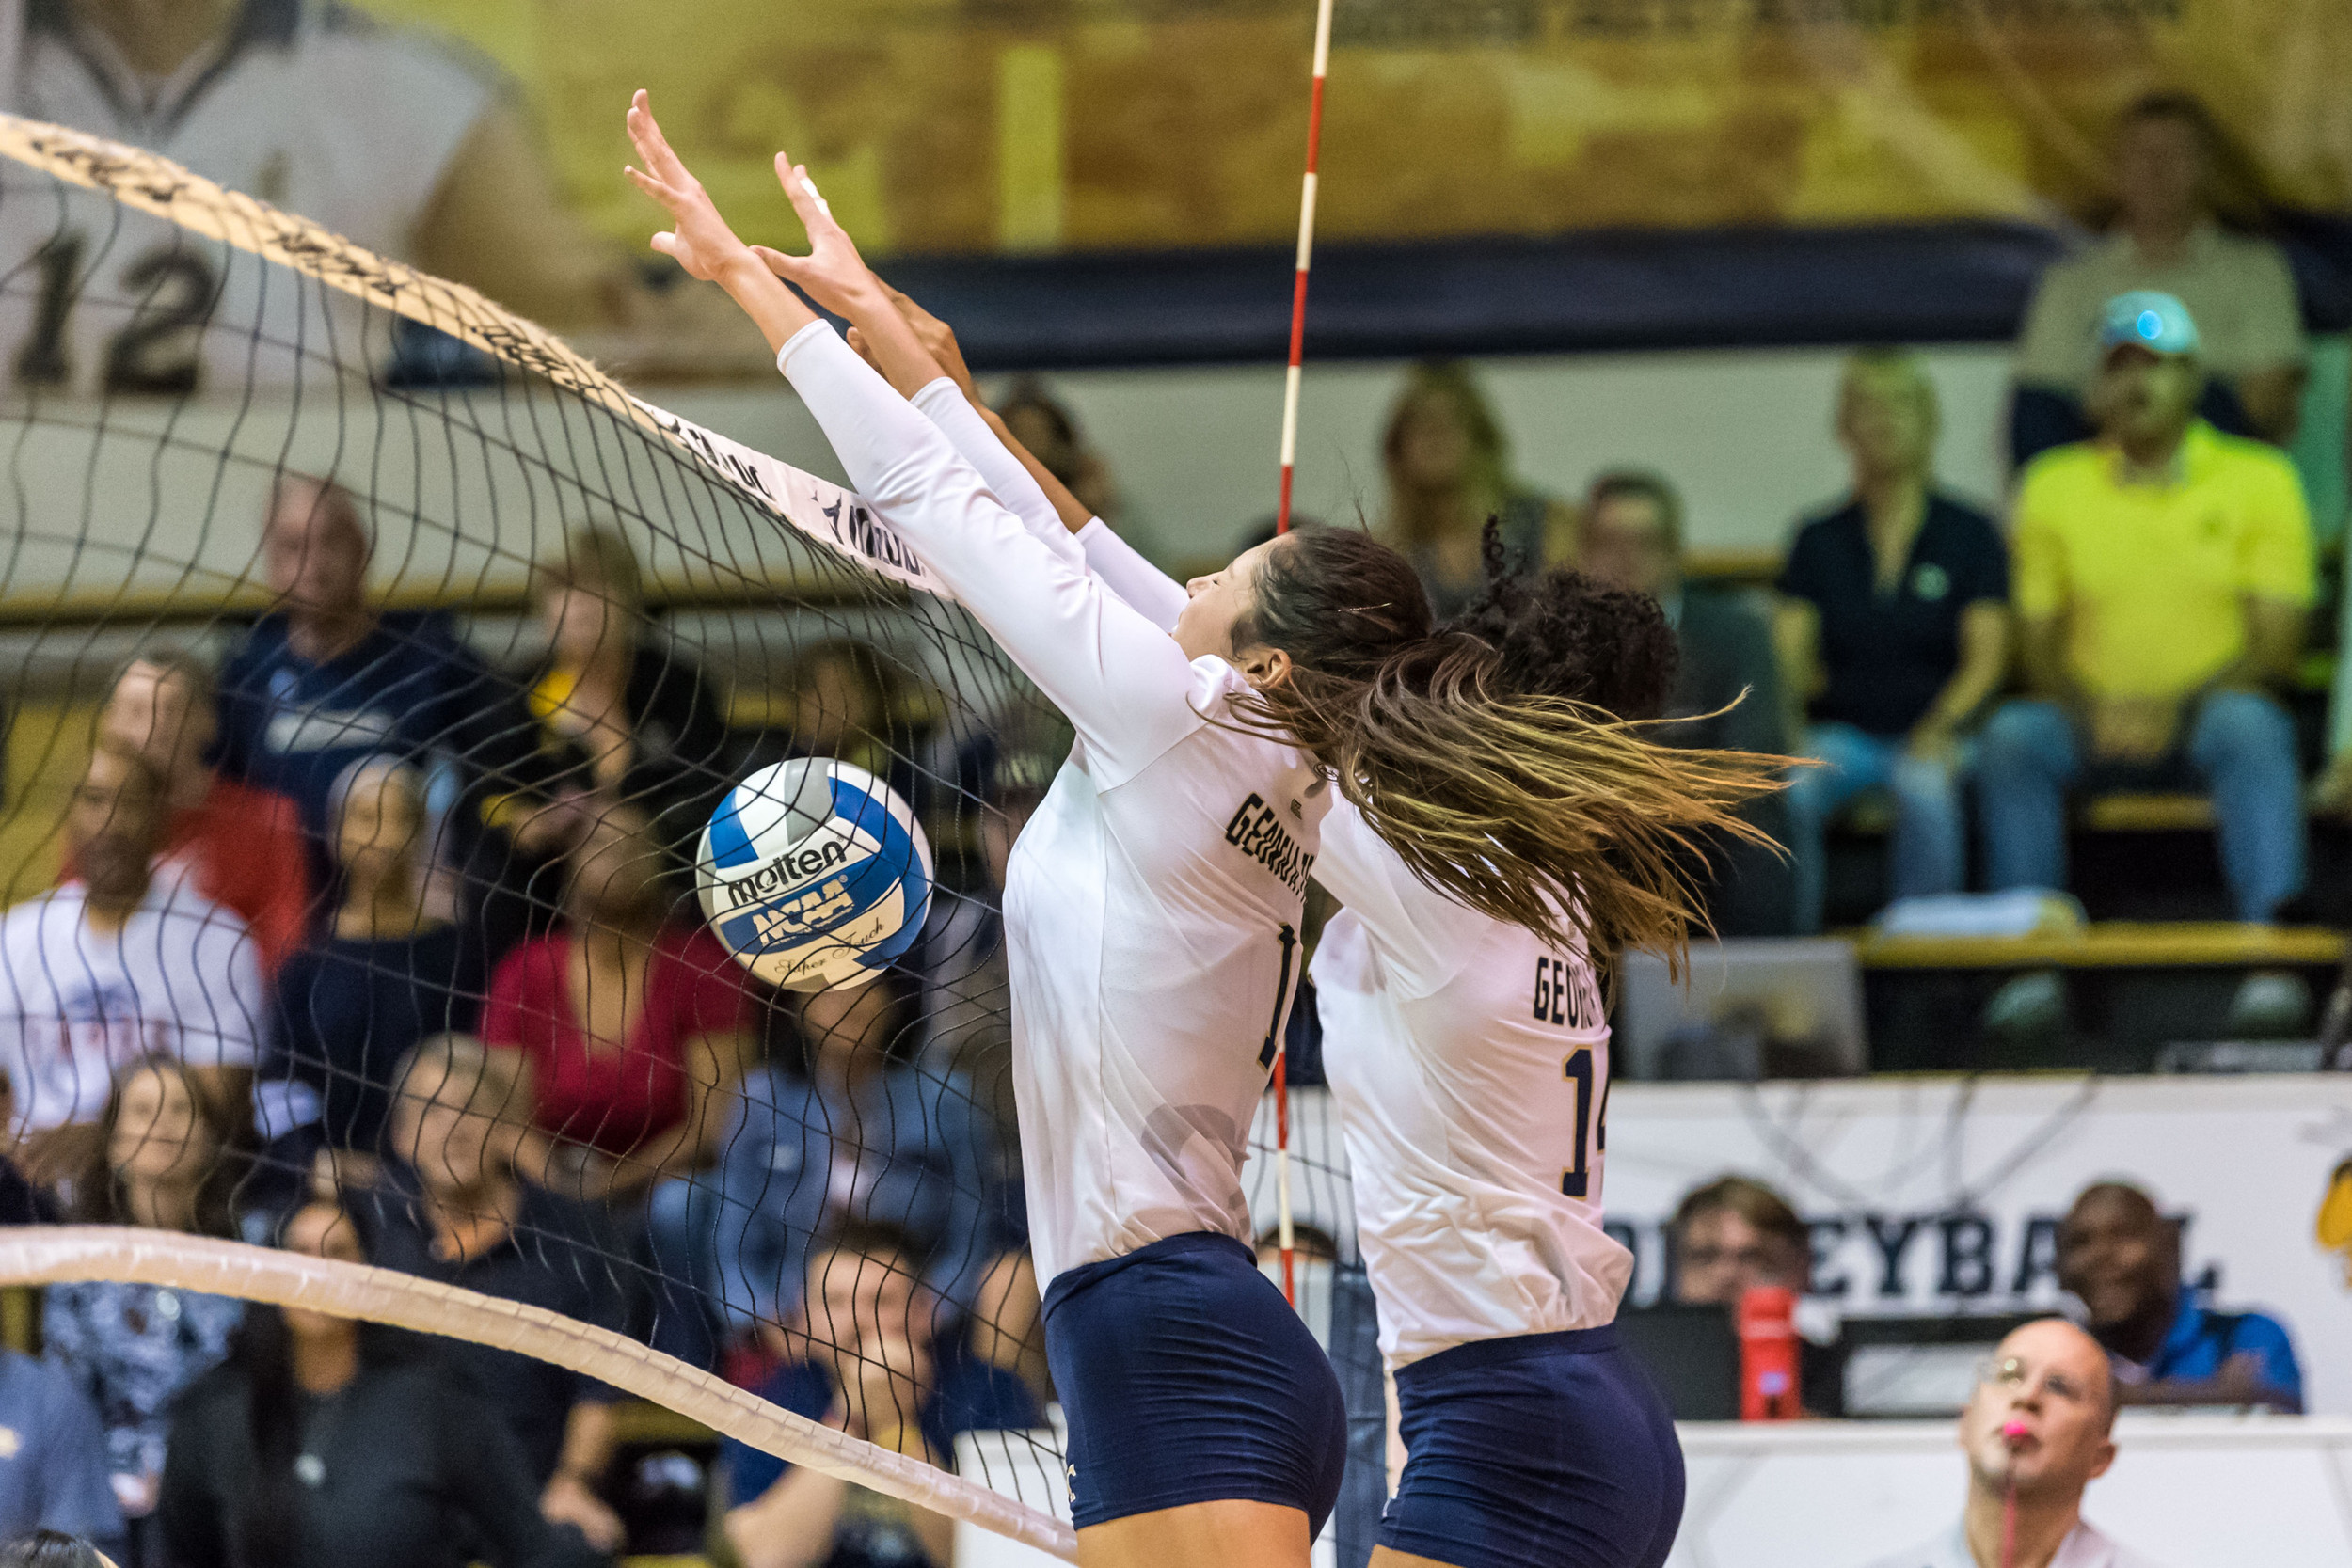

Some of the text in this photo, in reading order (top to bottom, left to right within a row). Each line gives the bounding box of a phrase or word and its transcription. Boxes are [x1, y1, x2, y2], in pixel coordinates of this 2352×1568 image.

[14, 235, 213, 395] 12
[728, 841, 847, 908] molten
[752, 879, 854, 948] NCAA
[774, 958, 828, 977] Super
